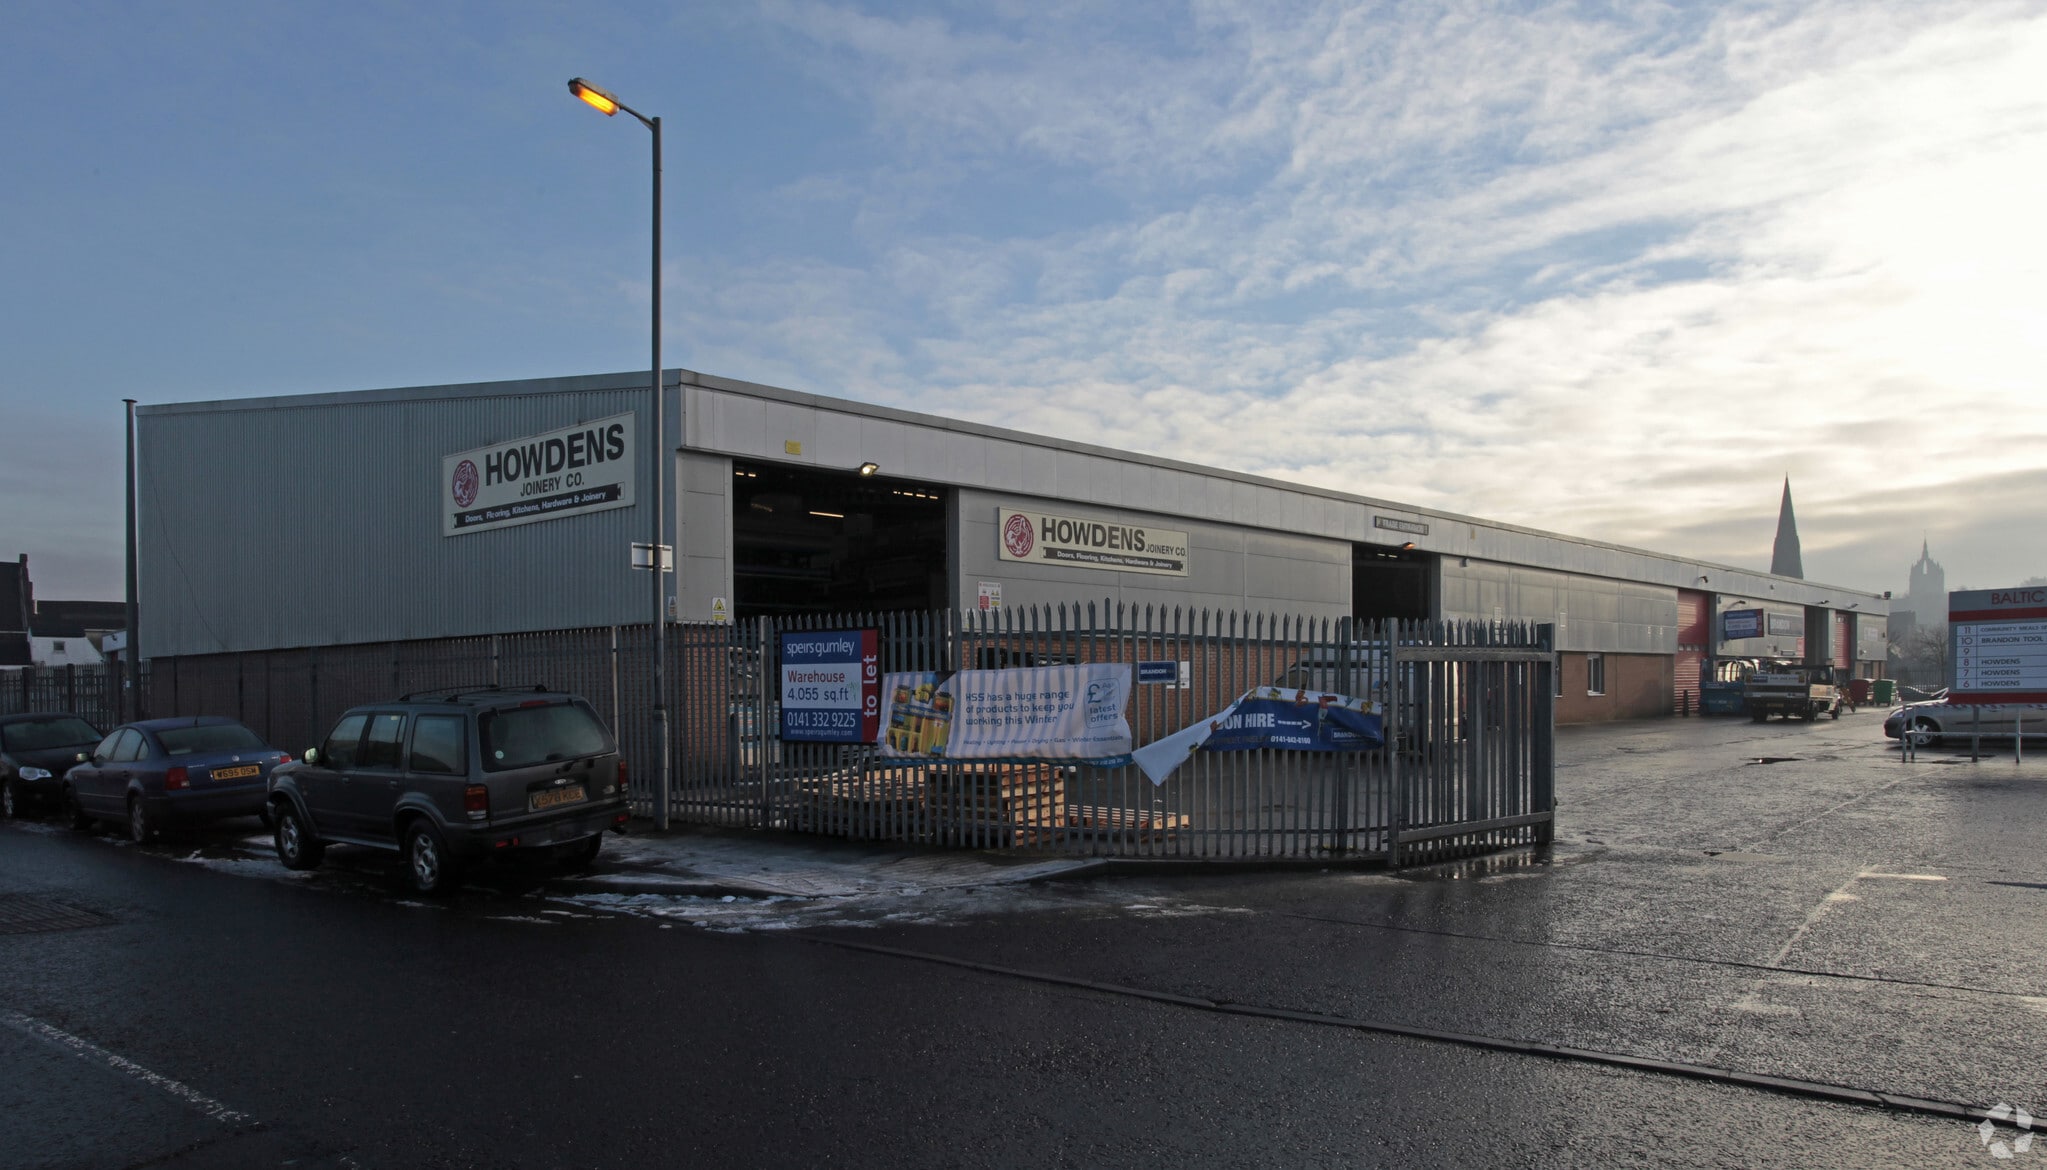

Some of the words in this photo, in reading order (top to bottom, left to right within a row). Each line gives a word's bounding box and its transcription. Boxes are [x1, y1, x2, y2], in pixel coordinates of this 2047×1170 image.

[485, 423, 625, 486] HOWDENS
[520, 476, 561, 497] JOINERY
[566, 471, 585, 487] CO.
[464, 514, 483, 523] Doors,
[486, 508, 511, 520] Flooring,
[512, 503, 540, 514] Kitchens,
[541, 498, 572, 509] Hardware
[574, 494, 580, 504] &
[580, 491, 606, 502] Joinery
[1041, 517, 1146, 552] HOWDENS
[1146, 544, 1174, 556] JOINERY
[1175, 547, 1187, 557] CO.
[1125, 558, 1149, 566] Hardware
[1154, 561, 1173, 570] Joinery
[1991, 590, 2045, 605] BALTIC
[787, 641, 814, 658] speirs
[815, 638, 855, 658] gumley
[1961, 637, 1973, 646] 10
[788, 669, 845, 683] Warehouse
[864, 654, 877, 684] let
[824, 687, 848, 703] sq.ft
[966, 692, 985, 702] HSS
[987, 692, 1003, 701] has
[1015, 692, 1037, 702] huge
[1040, 690, 1070, 702] range
[1088, 684, 1102, 704] £
[864, 694, 878, 718] to
[966, 706, 974, 714] of
[976, 704, 1018, 716] products
[1020, 704, 1030, 712] to
[1032, 702, 1056, 715] keep
[1058, 702, 1075, 714] you
[1090, 704, 1116, 714] latest
[787, 712, 809, 726] 0141
[812, 712, 830, 727] 332
[832, 712, 856, 728] 9225
[966, 716, 1002, 727] working
[1005, 714, 1023, 725] this
[1025, 714, 1057, 724] Winter
[1090, 713, 1119, 724] offers
[1216, 714, 1242, 730] ON
[1245, 713, 1276, 728] HIRE
